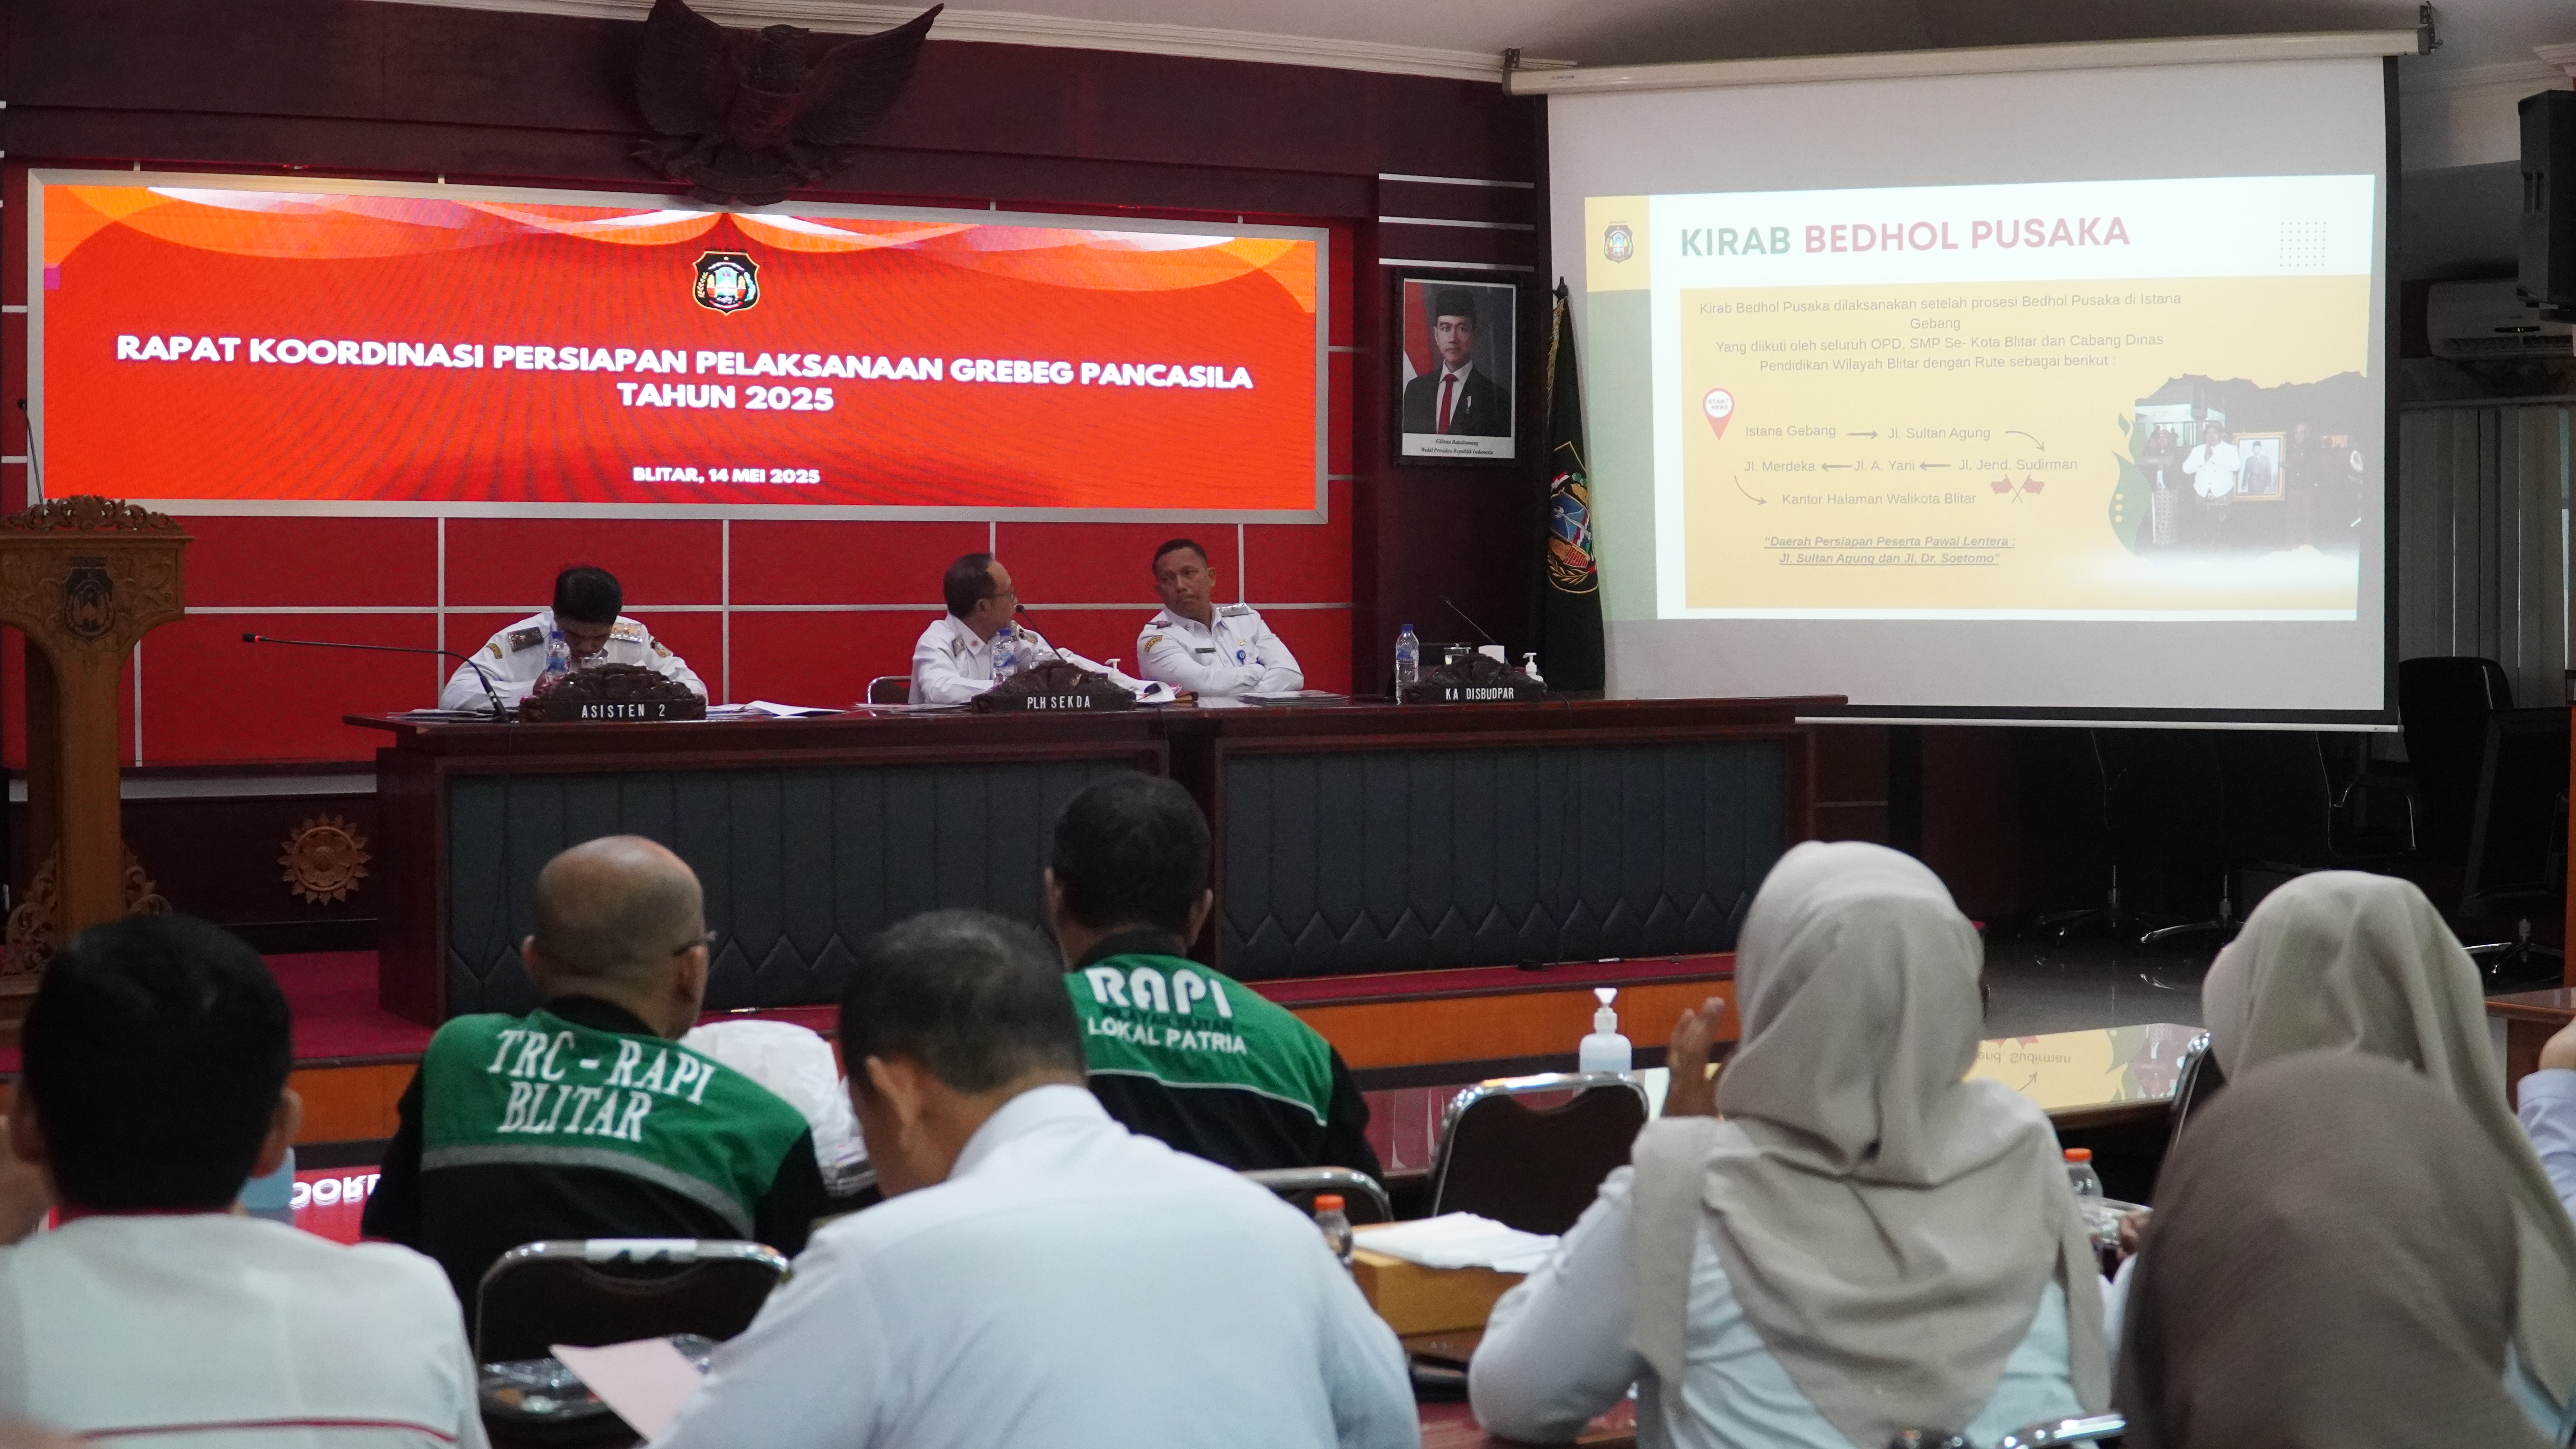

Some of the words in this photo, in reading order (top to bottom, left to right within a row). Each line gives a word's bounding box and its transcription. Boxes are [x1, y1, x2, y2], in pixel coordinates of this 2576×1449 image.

[1681, 227, 1791, 256] KIRAB
[1805, 221, 1959, 253] BEDHOL
[1971, 215, 2130, 249] PUSAKA
[1700, 303, 1732, 313] Kirab
[1736, 302, 1779, 313] Bedhol
[1784, 301, 1829, 312] Pusaka
[1834, 299, 1916, 311] dilaksanakan
[1921, 297, 1966, 309] setelah
[1972, 297, 2017, 310] prosesi
[2022, 295, 2067, 306] Bedhol
[2072, 294, 2120, 306] Pusaka
[2125, 294, 2136, 305] di
[2141, 294, 2181, 304] Istana
[1911, 318, 1961, 331] Gebang
[1716, 342, 1747, 355] Yang
[1751, 340, 1786, 352] diikuti
[1790, 340, 1816, 351] oleh
[1821, 339, 1866, 350] seluruh
[1871, 338, 1905, 351] OPD,
[1911, 338, 1940, 349] SMP
[1945, 337, 1966, 348] Se-
[1971, 336, 2000, 348] Kota
[2005, 335, 2037, 347] Blitar
[2041, 335, 2065, 346] dan
[2070, 334, 2121, 348] Cabang
[2126, 333, 2164, 346] Dinas
[117, 336, 240, 361] RAPAT
[251, 339, 484, 369] KOORDINASI
[493, 345, 687, 374] PERSIAPAN
[696, 351, 943, 381] PELAKSANAAN
[951, 359, 1074, 385] GREBEG
[1081, 363, 1253, 389] PANCASILA
[1760, 359, 1828, 371] Pendidikan
[1832, 358, 1883, 373] Wilayah
[1887, 358, 1919, 369] Blitar
[1923, 357, 1971, 371] dengan
[1975, 357, 2005, 368] Rute
[2009, 355, 2060, 369] sebagai
[2064, 355, 2109, 366] berikut
[618, 382, 735, 409] TAHUN
[745, 385, 833, 411] 2025
[1746, 426, 1783, 436] Istana
[1787, 425, 1836, 438] Gebang
[1888, 428, 1900, 439] Jl.
[1906, 428, 1946, 439] Sultan
[1950, 428, 1990, 441] Agung
[1744, 461, 1756, 472] Jl.
[1763, 461, 1816, 471] Merdeka
[1853, 461, 1866, 471] Jl.
[1871, 461, 1883, 471] A.
[1888, 460, 1915, 470] Yani
[1959, 460, 1971, 470] Jl.
[1977, 459, 2011, 470] Jend.
[2016, 459, 2077, 470] Sudirman
[633, 467, 704, 483] BLITAR,
[708, 468, 728, 483] 14
[732, 468, 766, 483] MEI
[770, 469, 820, 484] 2025
[1782, 494, 1823, 504] Kantor
[1827, 494, 1882, 504] Halaman
[1887, 493, 1940, 504] Walikota
[1945, 493, 1976, 504] Blitar
[1814, 536, 1872, 548] Persiapan
[1877, 536, 1921, 546] Peserta
[1924, 536, 1959, 546] Pawai
[1963, 536, 2008, 546] Lentera
[1779, 553, 1792, 564] Jl.
[1797, 553, 1832, 564] Sultan
[1836, 554, 1874, 565] Agung
[1878, 553, 1900, 563] dan
[1904, 554, 1917, 563] Jl.
[1921, 554, 1936, 563] Dr.
[1446, 688, 1458, 700] KA
[1466, 687, 1514, 700] DISBUDPAR
[1027, 697, 1046, 709] PLH
[1051, 695, 1090, 709] SEKDA
[581, 704, 645, 718] ASISTEN
[658, 704, 666, 717] 2
[1085, 967, 1233, 1019] RAPI
[1088, 1017, 1160, 1046] LOKAL
[1166, 1029, 1247, 1055] PATRIA
[487, 1030, 575, 1080] TRC
[603, 1039, 716, 1105] RAPI
[497, 1082, 654, 1142] BLITAR
